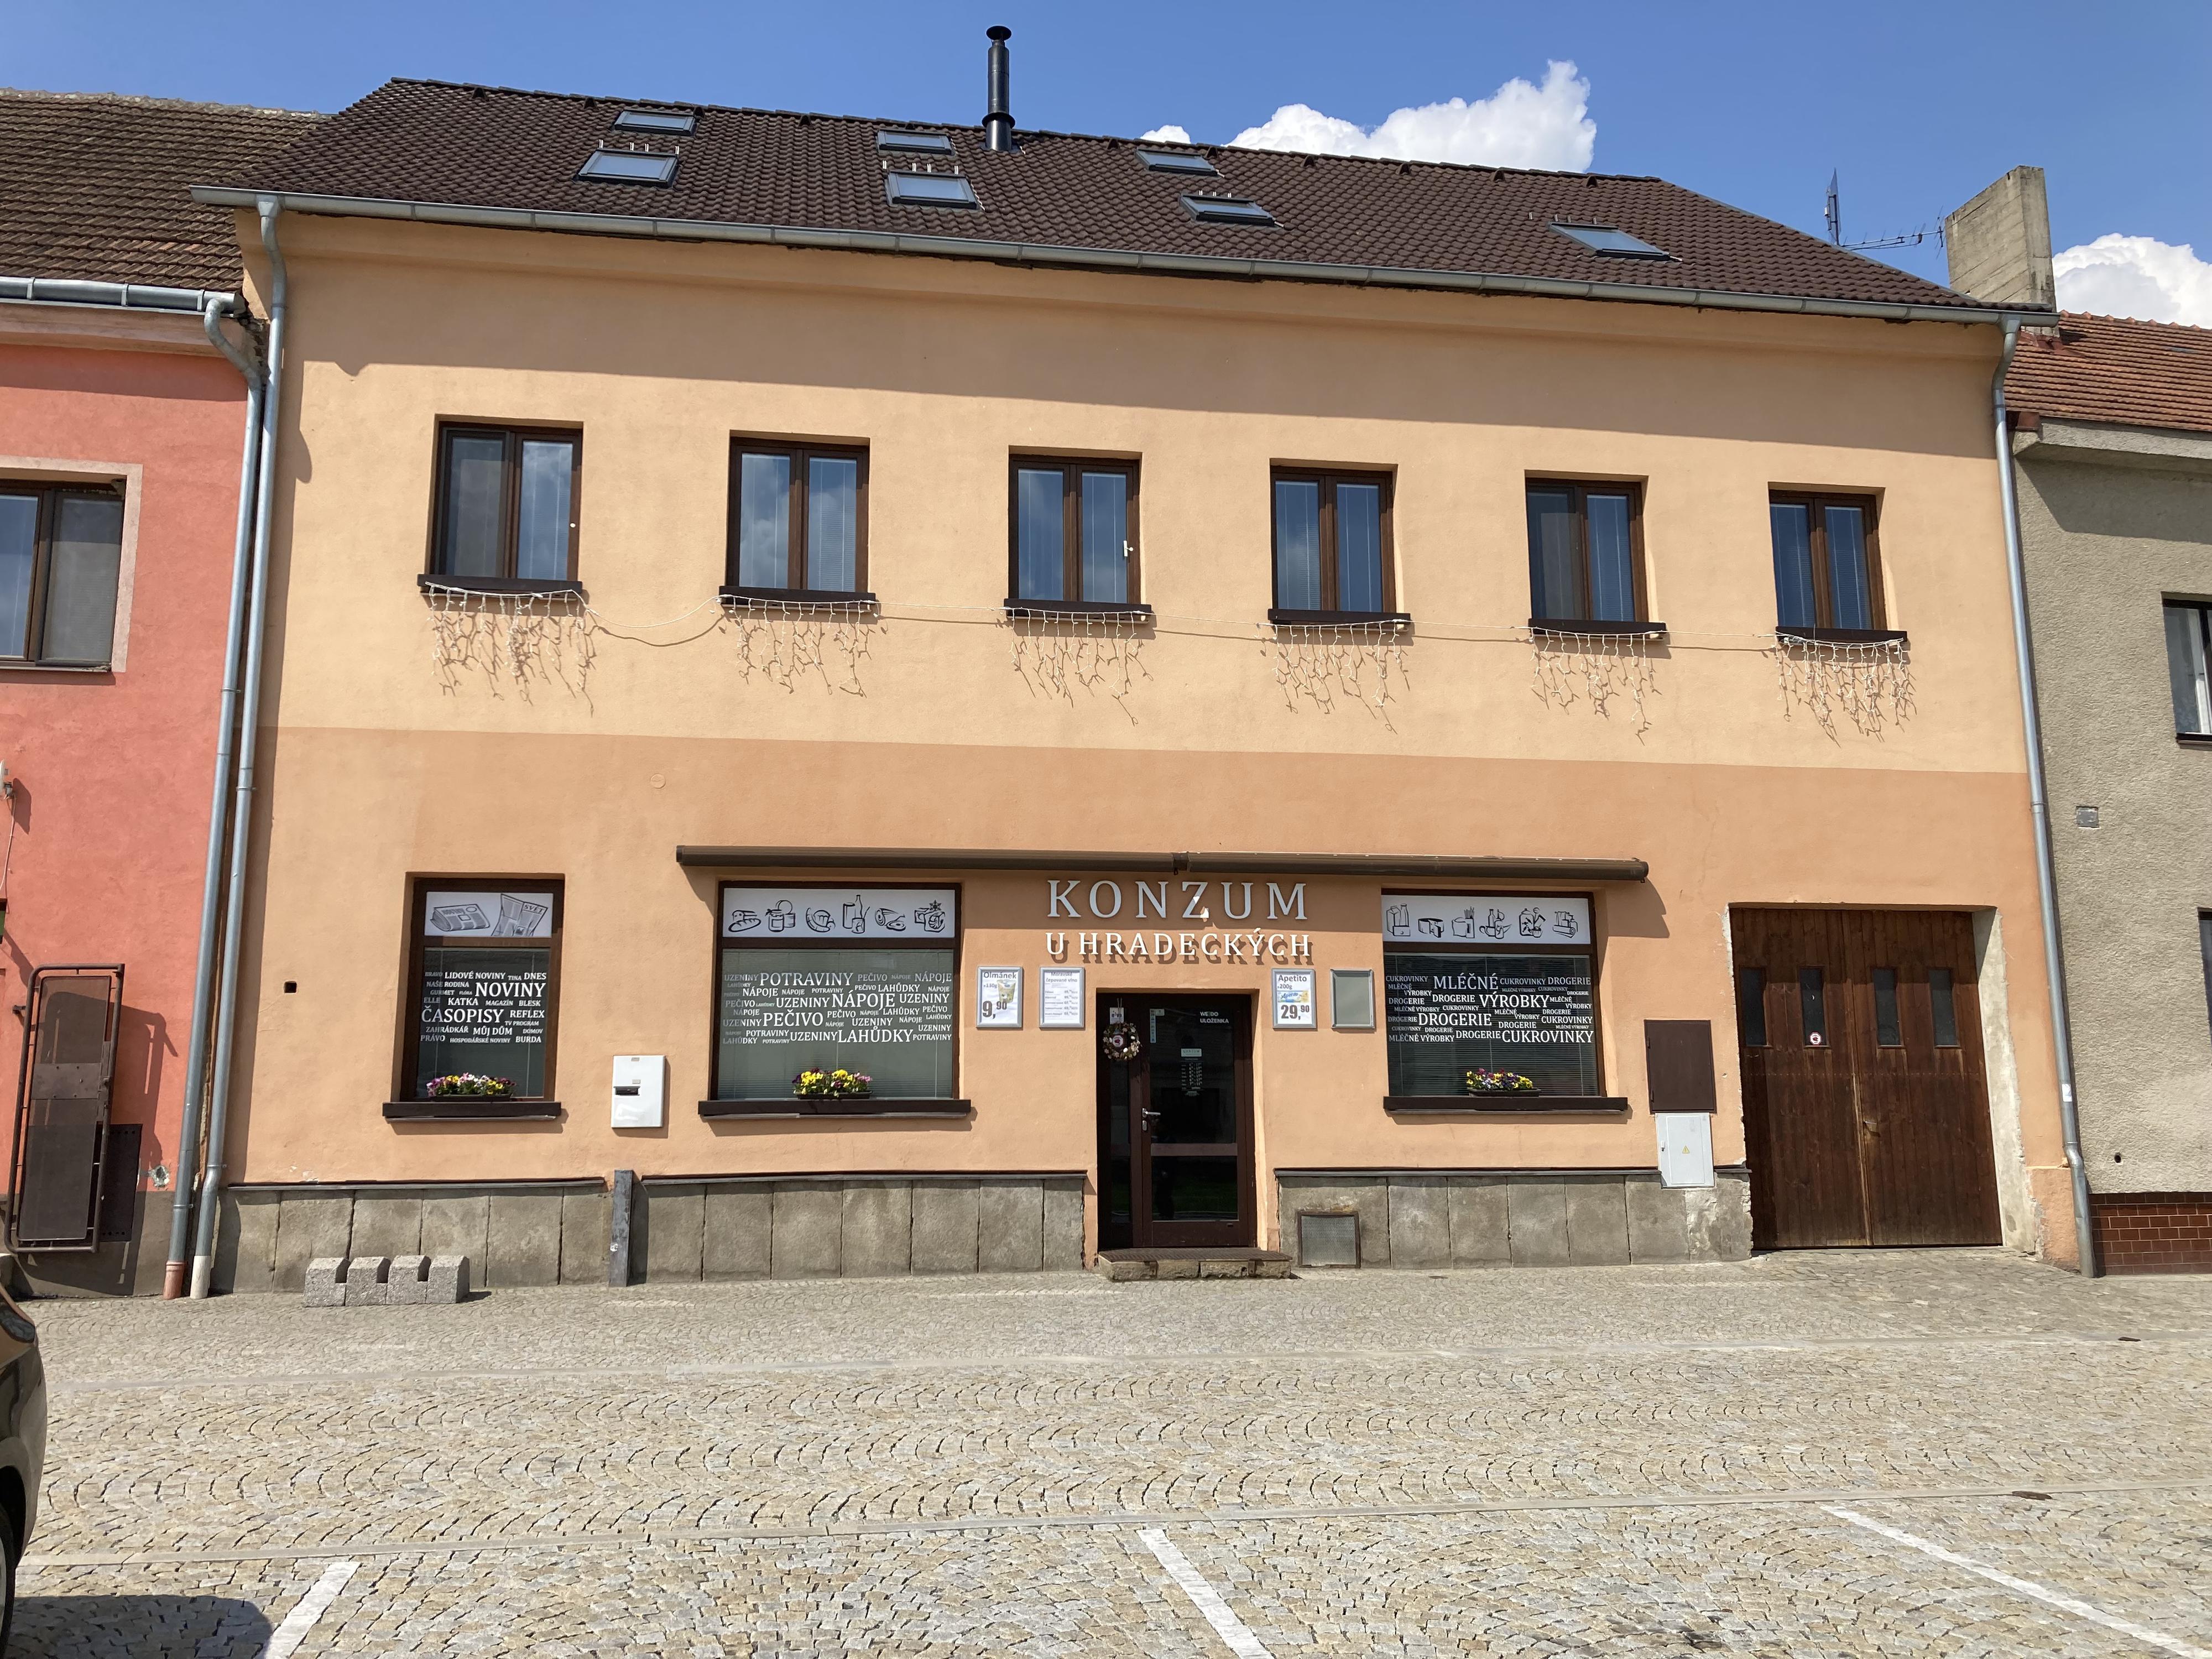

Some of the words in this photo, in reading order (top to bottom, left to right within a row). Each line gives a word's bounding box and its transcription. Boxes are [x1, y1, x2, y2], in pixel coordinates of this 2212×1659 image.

[1047, 880, 1307, 920] KONZUM
[1046, 932, 1065, 954] U
[1078, 927, 1310, 956] HRADECKÝCH
[445, 971, 473, 979] LIDOVÉ
[760, 972, 854, 986] POTRAVINY
[858, 972, 888, 982] PEČIVO
[915, 971, 952, 984] NÁPOJE
[1279, 974, 1307, 983] Apetito
[1433, 972, 1499, 990] MLÉČNÉ
[1547, 977, 1591, 985] DROGERIE
[475, 982, 546, 997] NOVINY
[742, 986, 779, 998] NÁPOJE
[781, 988, 805, 996] NÁPOJE
[878, 982, 920, 992] LAHŮDKY
[448, 998, 478, 1006] KATKA
[776, 997, 830, 1008] UZENINY
[831, 989, 895, 1011] NÁPOJE
[899, 993, 950, 1003] UZENINY
[1432, 994, 1475, 1003] DROGERIE
[1479, 991, 1550, 1008] VÝROBKY
[725, 999, 755, 1008] PEČIVO
[421, 1005, 504, 1022] ČASOPISY
[510, 1010, 545, 1018] REFLEX
[733, 1008, 760, 1016] NÁPOJE
[827, 1009, 857, 1018] PEČIVO
[883, 1006, 920, 1015] LAHŮDKY
[982, 1000, 1007, 1019] 9,90
[1281, 1004, 1310, 1020] 29,90
[763, 1009, 824, 1026] PEČIVO
[852, 1018, 893, 1026] UZENINY
[899, 1015, 922, 1024] NÁPOJE
[1418, 1013, 1492, 1026] DROGERIE
[723, 1019, 762, 1027] UZENINY
[473, 1026, 490, 1036] MŮJ
[492, 1026, 513, 1035] DŮM
[790, 1031, 838, 1041] UZENINY
[838, 1026, 914, 1042] LAHŮDKY
[1455, 1030, 1501, 1039] DROGERIE
[420, 1034, 445, 1042] PRÁVO
[723, 1036, 758, 1044] LAHŮDKY
[1389, 1033, 1419, 1042] MLÉČNÉ
[1420, 1033, 1454, 1042] VÝROBKY
[1502, 1030, 1594, 1043] CUKROVINKY
